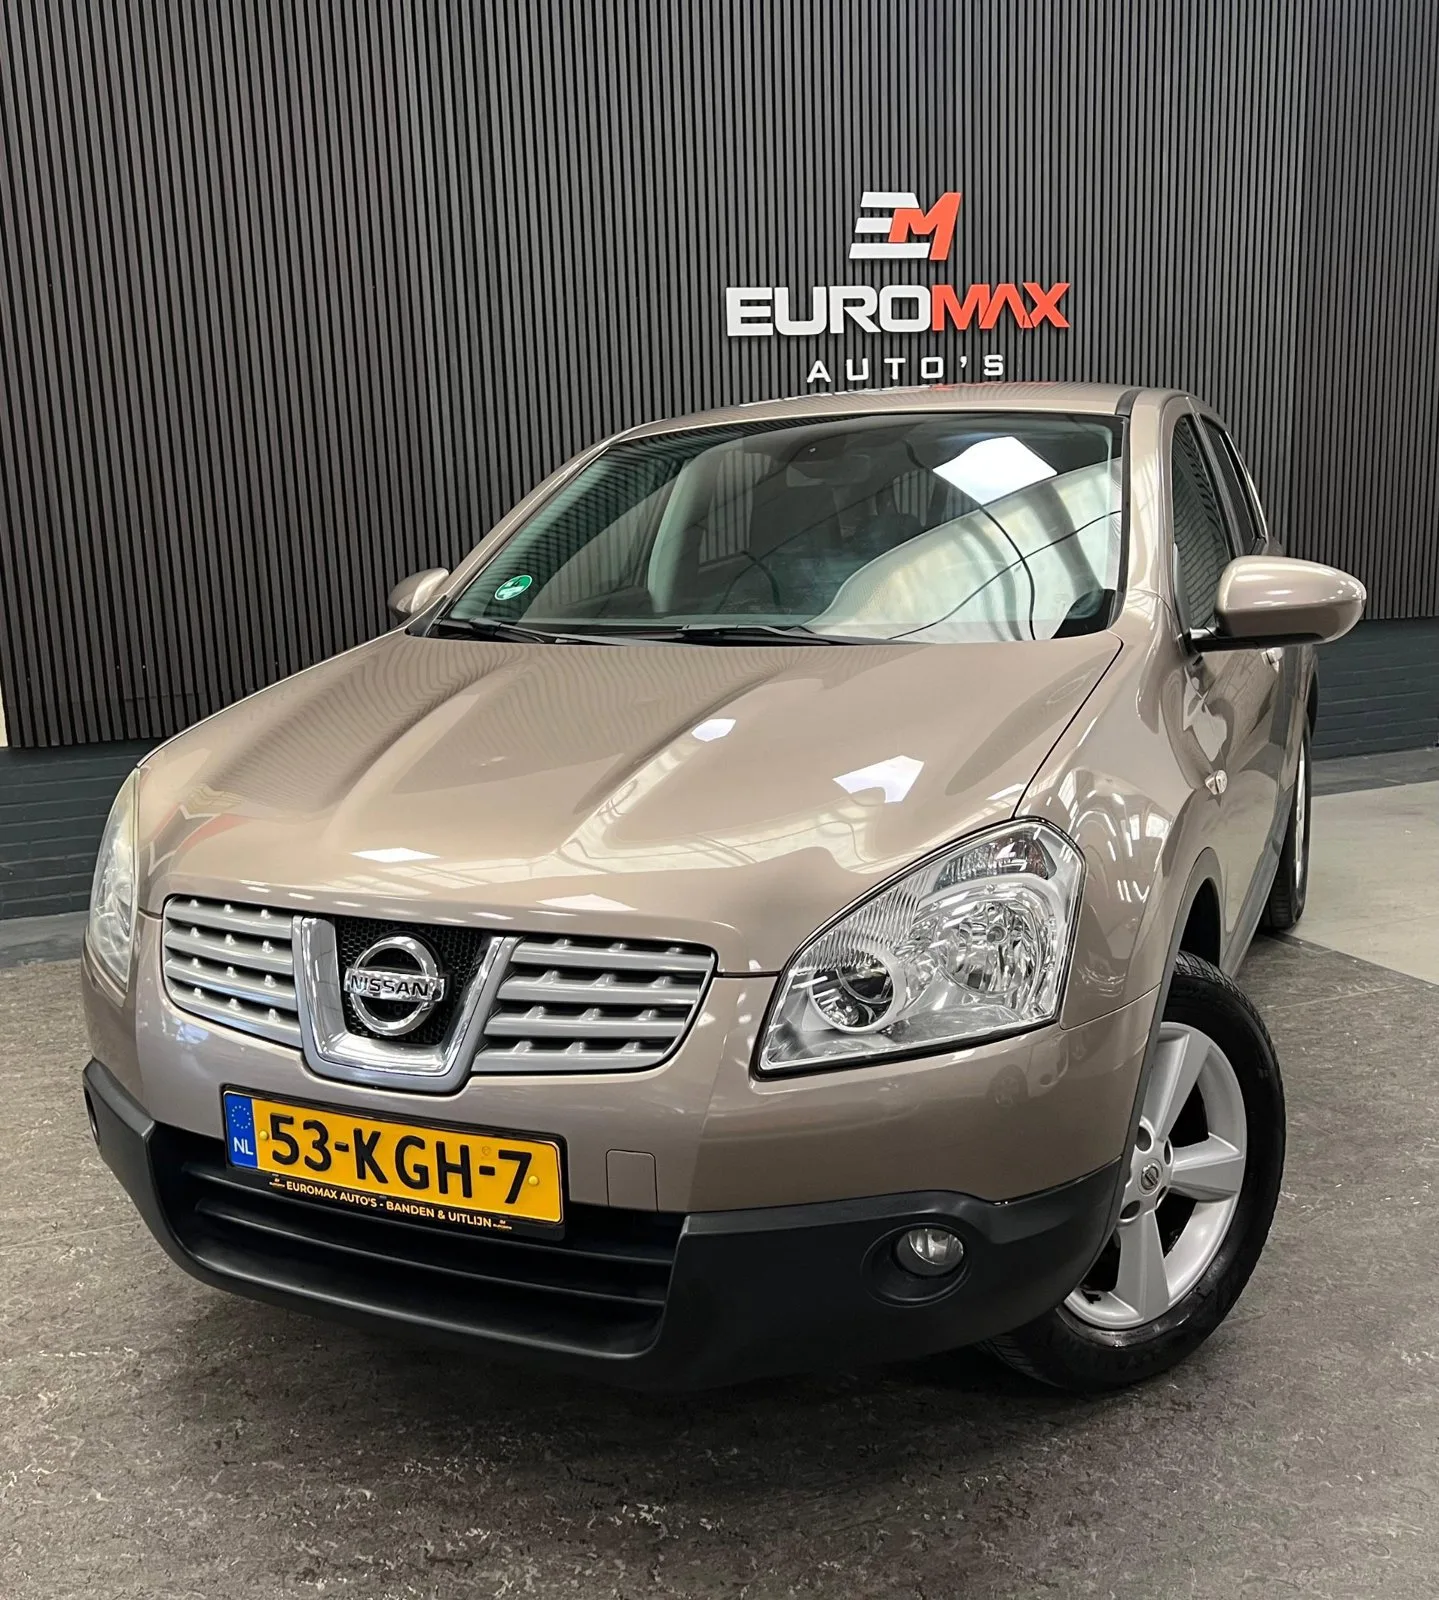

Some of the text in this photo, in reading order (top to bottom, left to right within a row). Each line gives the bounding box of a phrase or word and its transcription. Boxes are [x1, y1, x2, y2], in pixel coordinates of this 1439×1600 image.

[725, 282, 1071, 336] EUROMAX
[806, 354, 1004, 383] AUTO'S
[350, 975, 428, 996] NISSAN
[233, 1137, 254, 1155] NL
[269, 1112, 532, 1204] 53-KGH-7
[286, 1181, 338, 1200] EUROMAX
[340, 1192, 377, 1208] AUTO'S
[386, 1201, 435, 1218] BANDEN
[437, 1210, 446, 1220] &
[448, 1211, 492, 1228] UITLIJN
